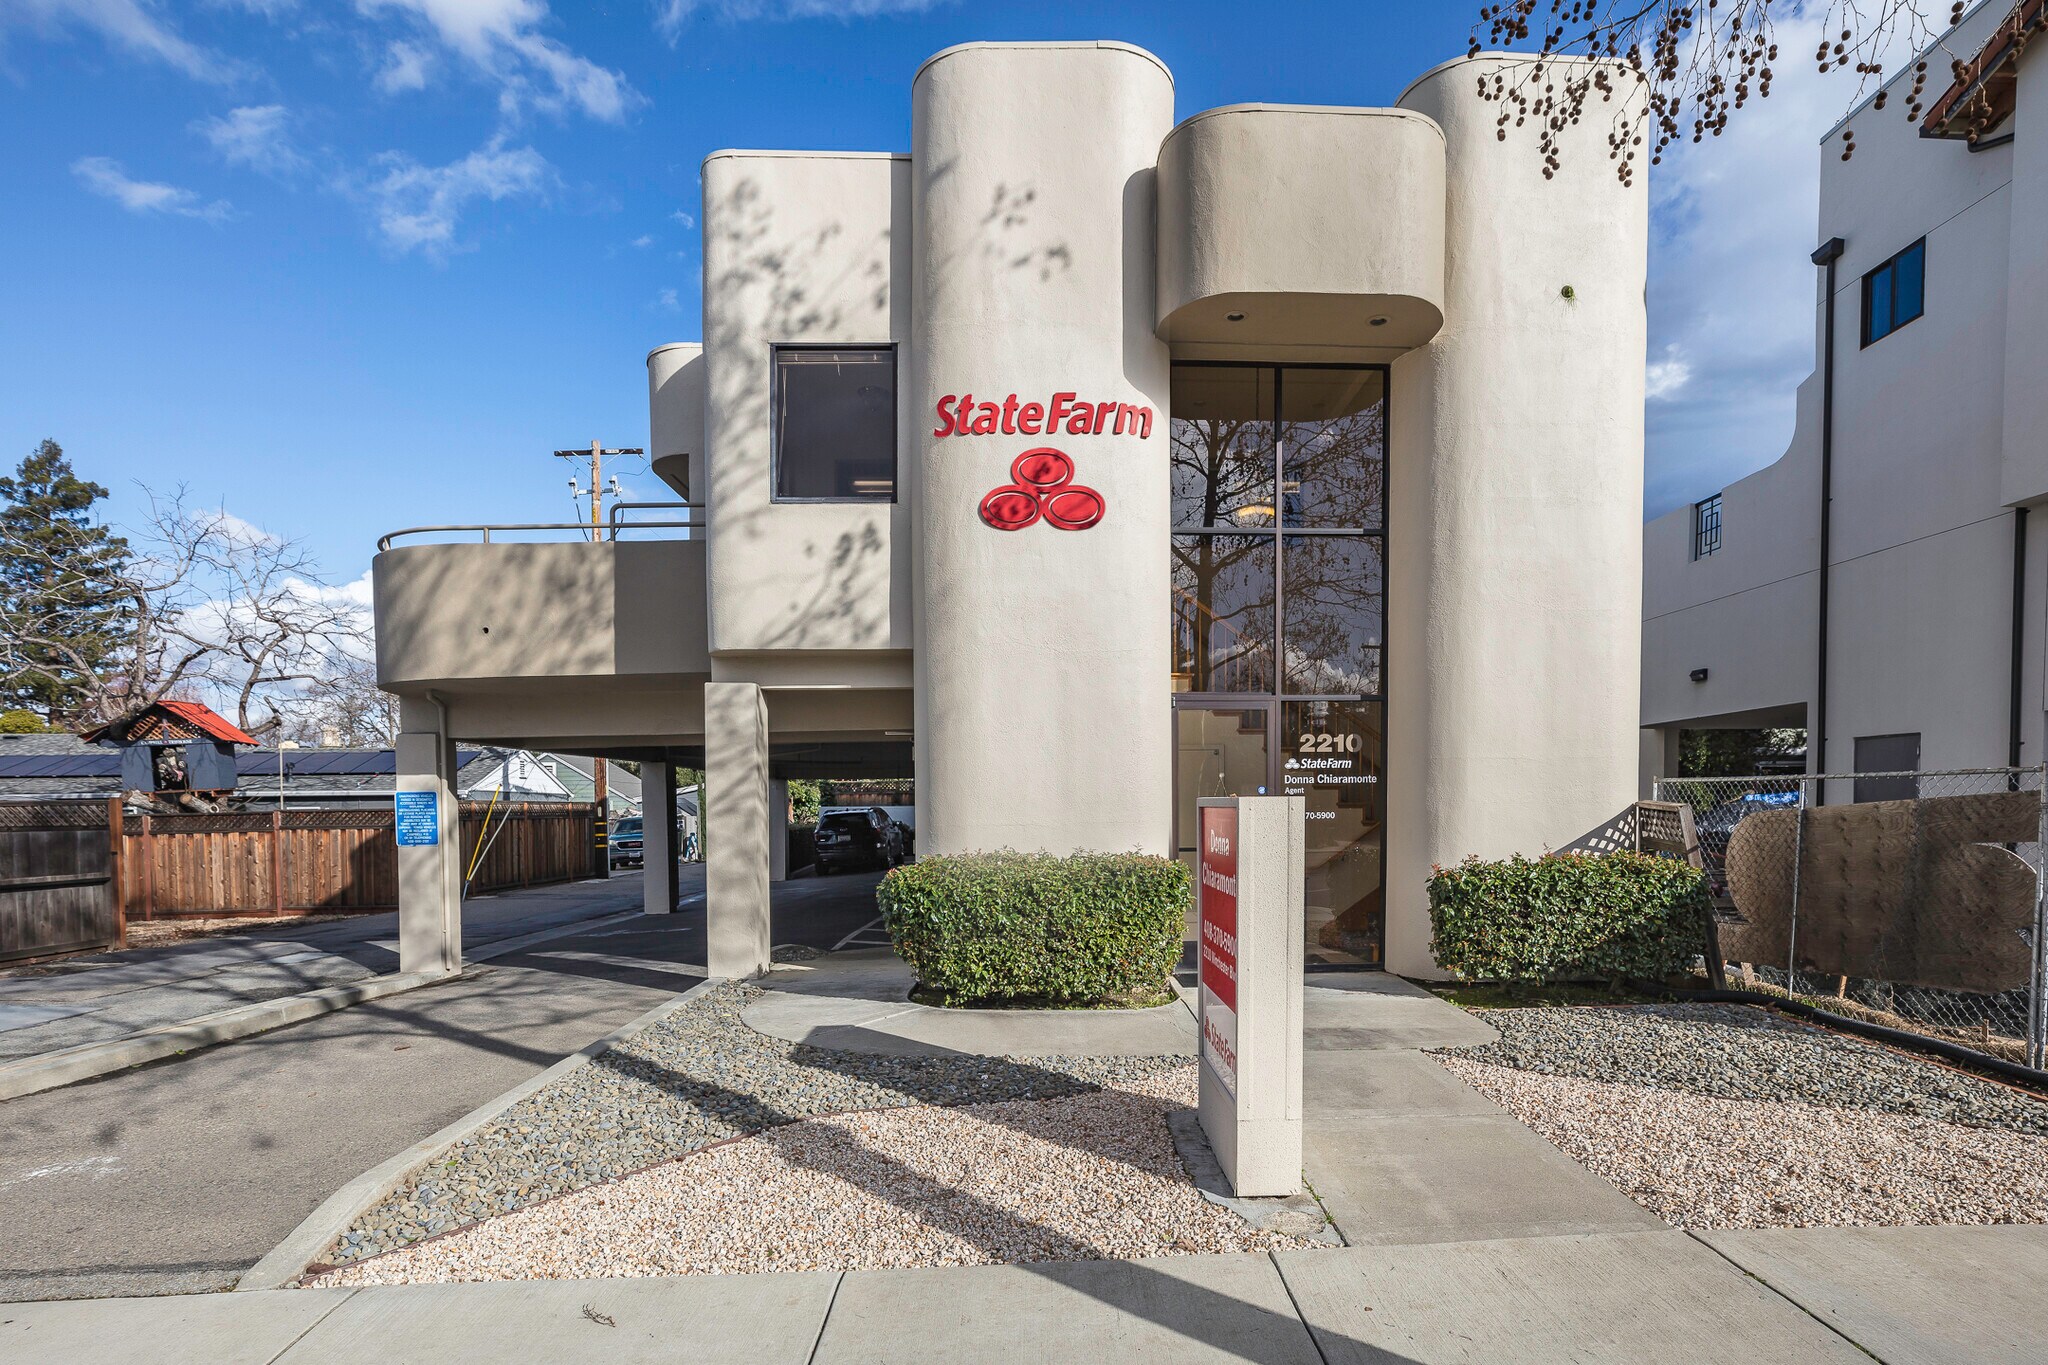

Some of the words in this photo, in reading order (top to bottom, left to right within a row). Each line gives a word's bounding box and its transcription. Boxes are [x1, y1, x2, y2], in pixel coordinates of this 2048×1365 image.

[1300, 733, 1363, 753] 2210
[1284, 775, 1314, 784] Donna
[1317, 774, 1378, 784] Chiaramonte
[1284, 787, 1305, 795] Agent
[1210, 829, 1230, 856] Donna
[1202, 861, 1237, 897] Chiaramont
